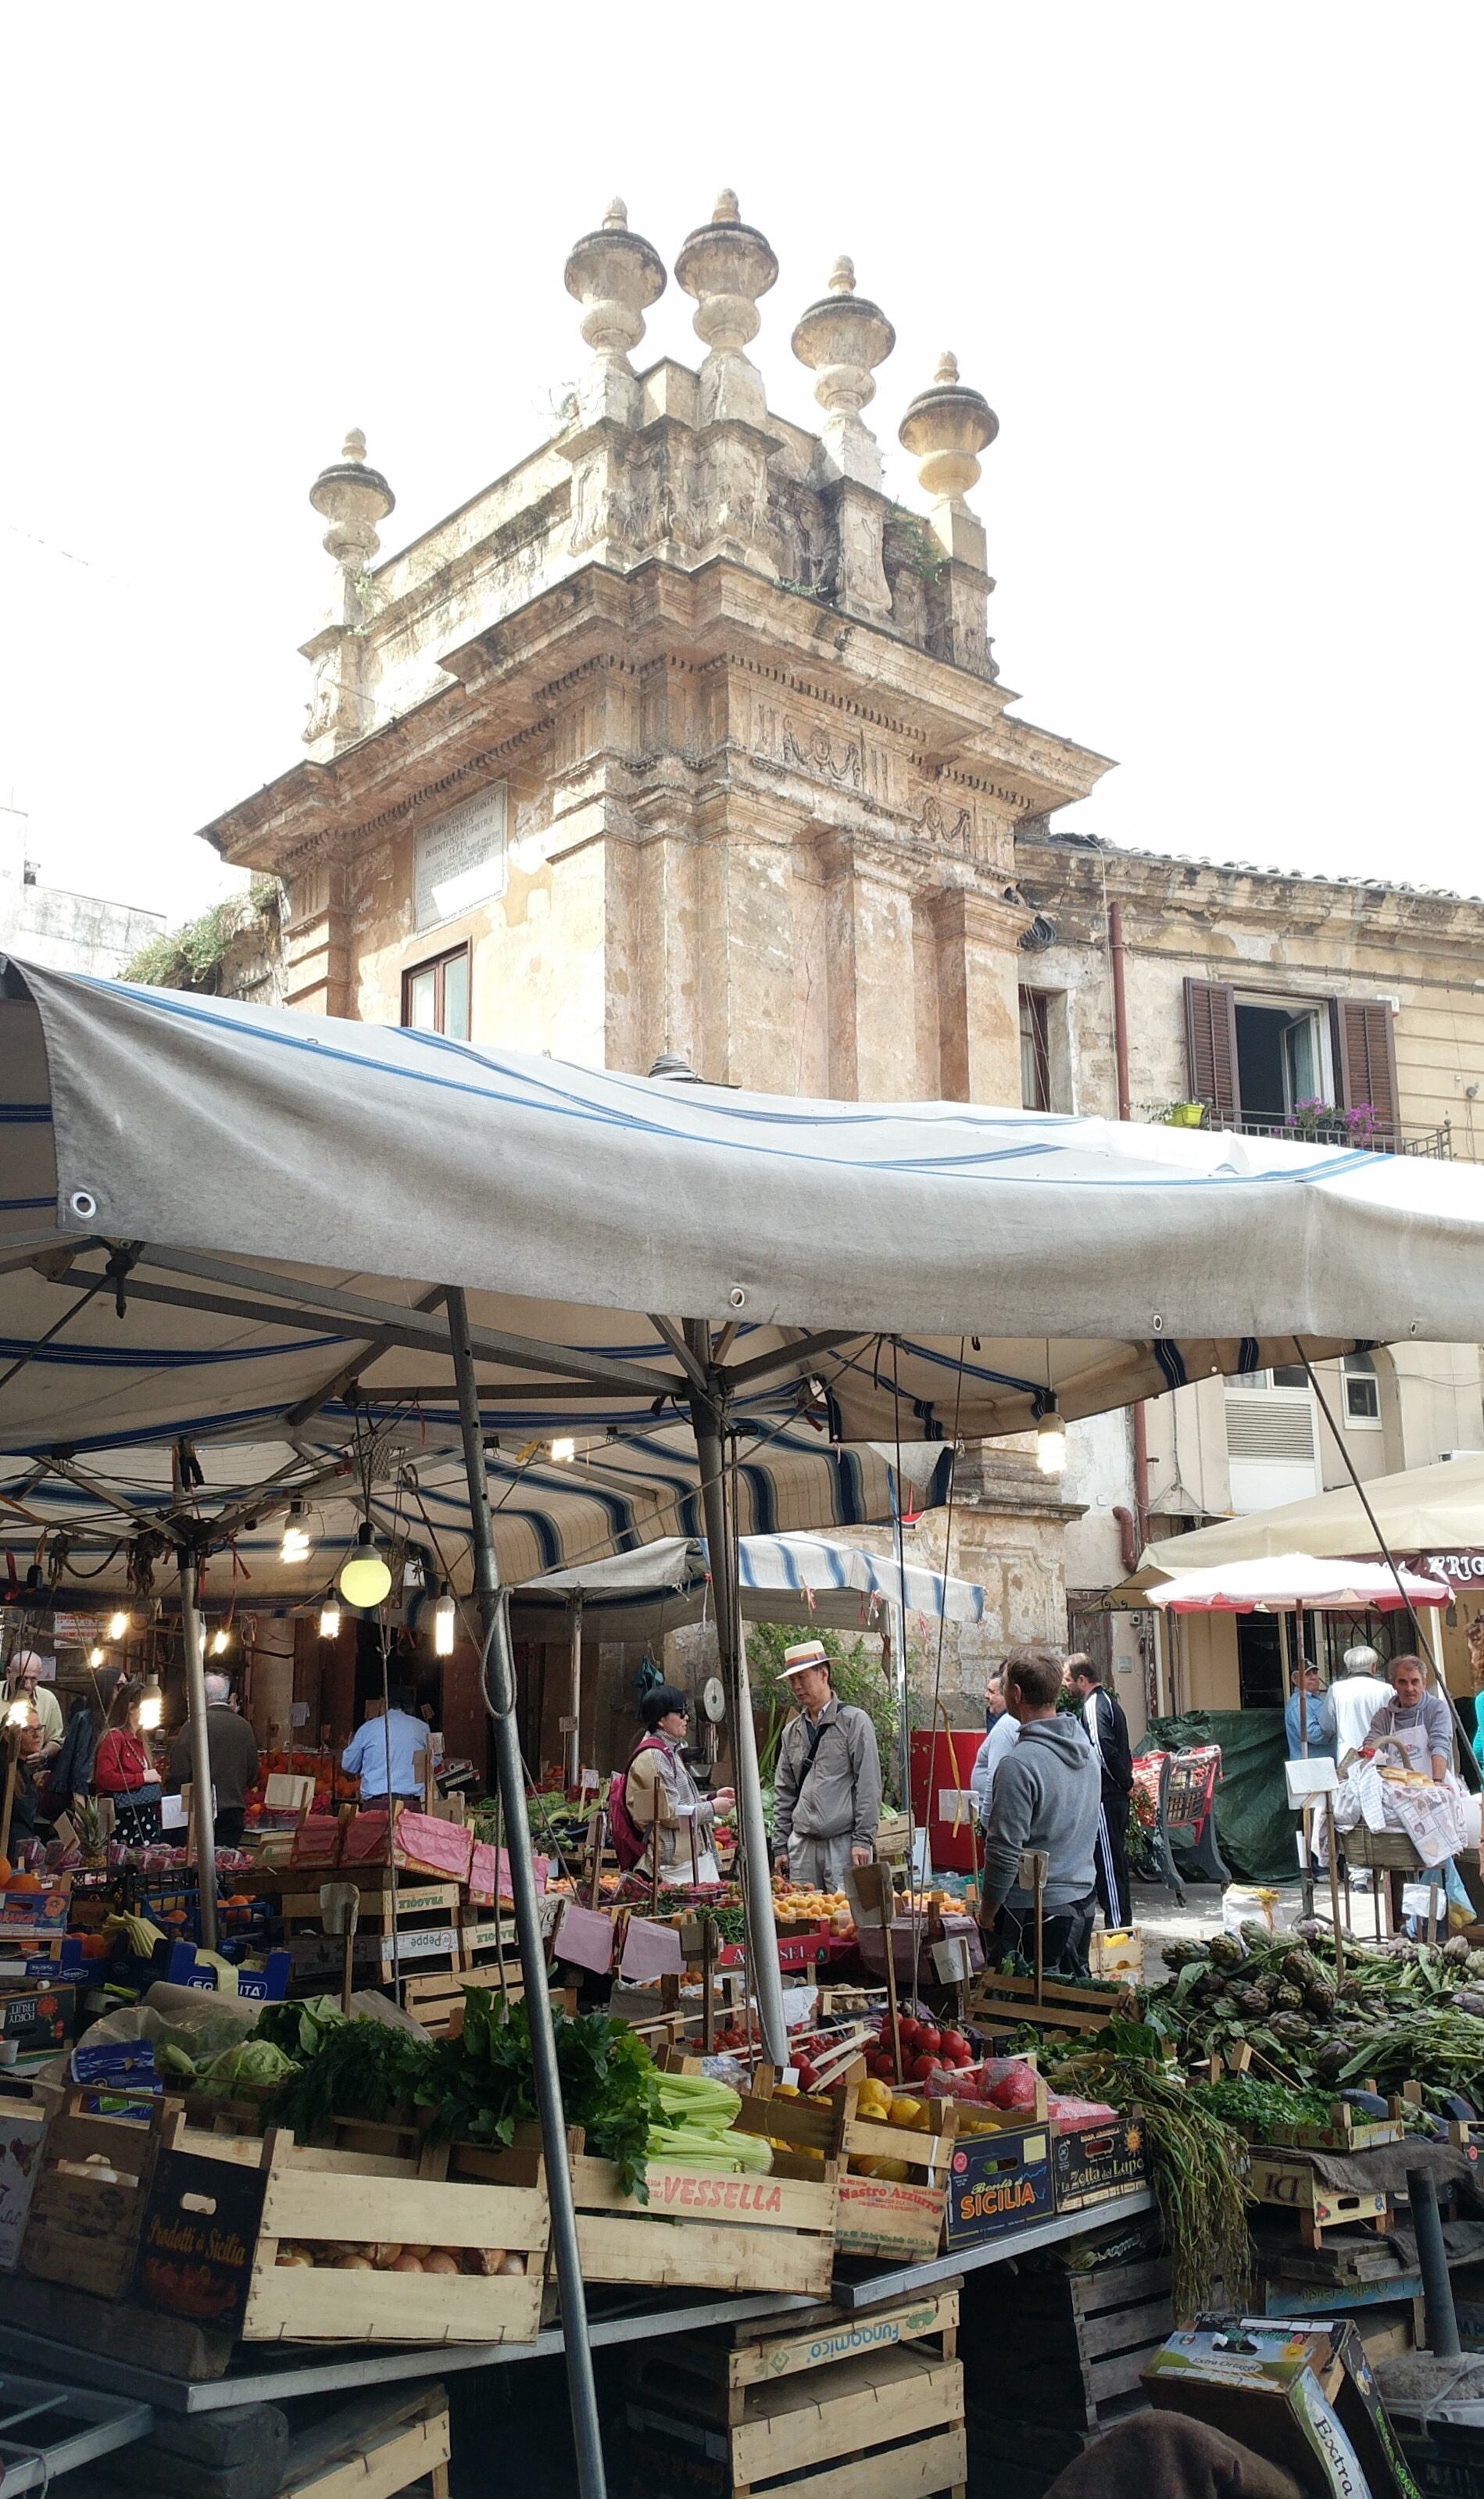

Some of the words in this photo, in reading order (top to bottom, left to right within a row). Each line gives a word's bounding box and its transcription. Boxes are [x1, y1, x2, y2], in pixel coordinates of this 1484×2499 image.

[399, 1895, 444, 1909] FRAGOLE
[411, 1937, 441, 1947] Peppe
[9, 2002, 35, 2014] FRUIT
[9, 2012, 35, 2025] FORTY
[1113, 2158, 1145, 2178] Lupo
[664, 2175, 781, 2212] VESSELLA
[1264, 2172, 1303, 2203] Di
[839, 2187, 887, 2202] Nastro
[890, 2187, 939, 2215] Azzurro
[960, 2182, 1035, 2220] SICILIA
[147, 2214, 195, 2253] Prodotti
[206, 2227, 246, 2266] Sicilia
[1193, 2356, 1218, 2366] Extra
[1219, 2359, 1260, 2373] Ortaggi
[1314, 2415, 1353, 2497] Extra
